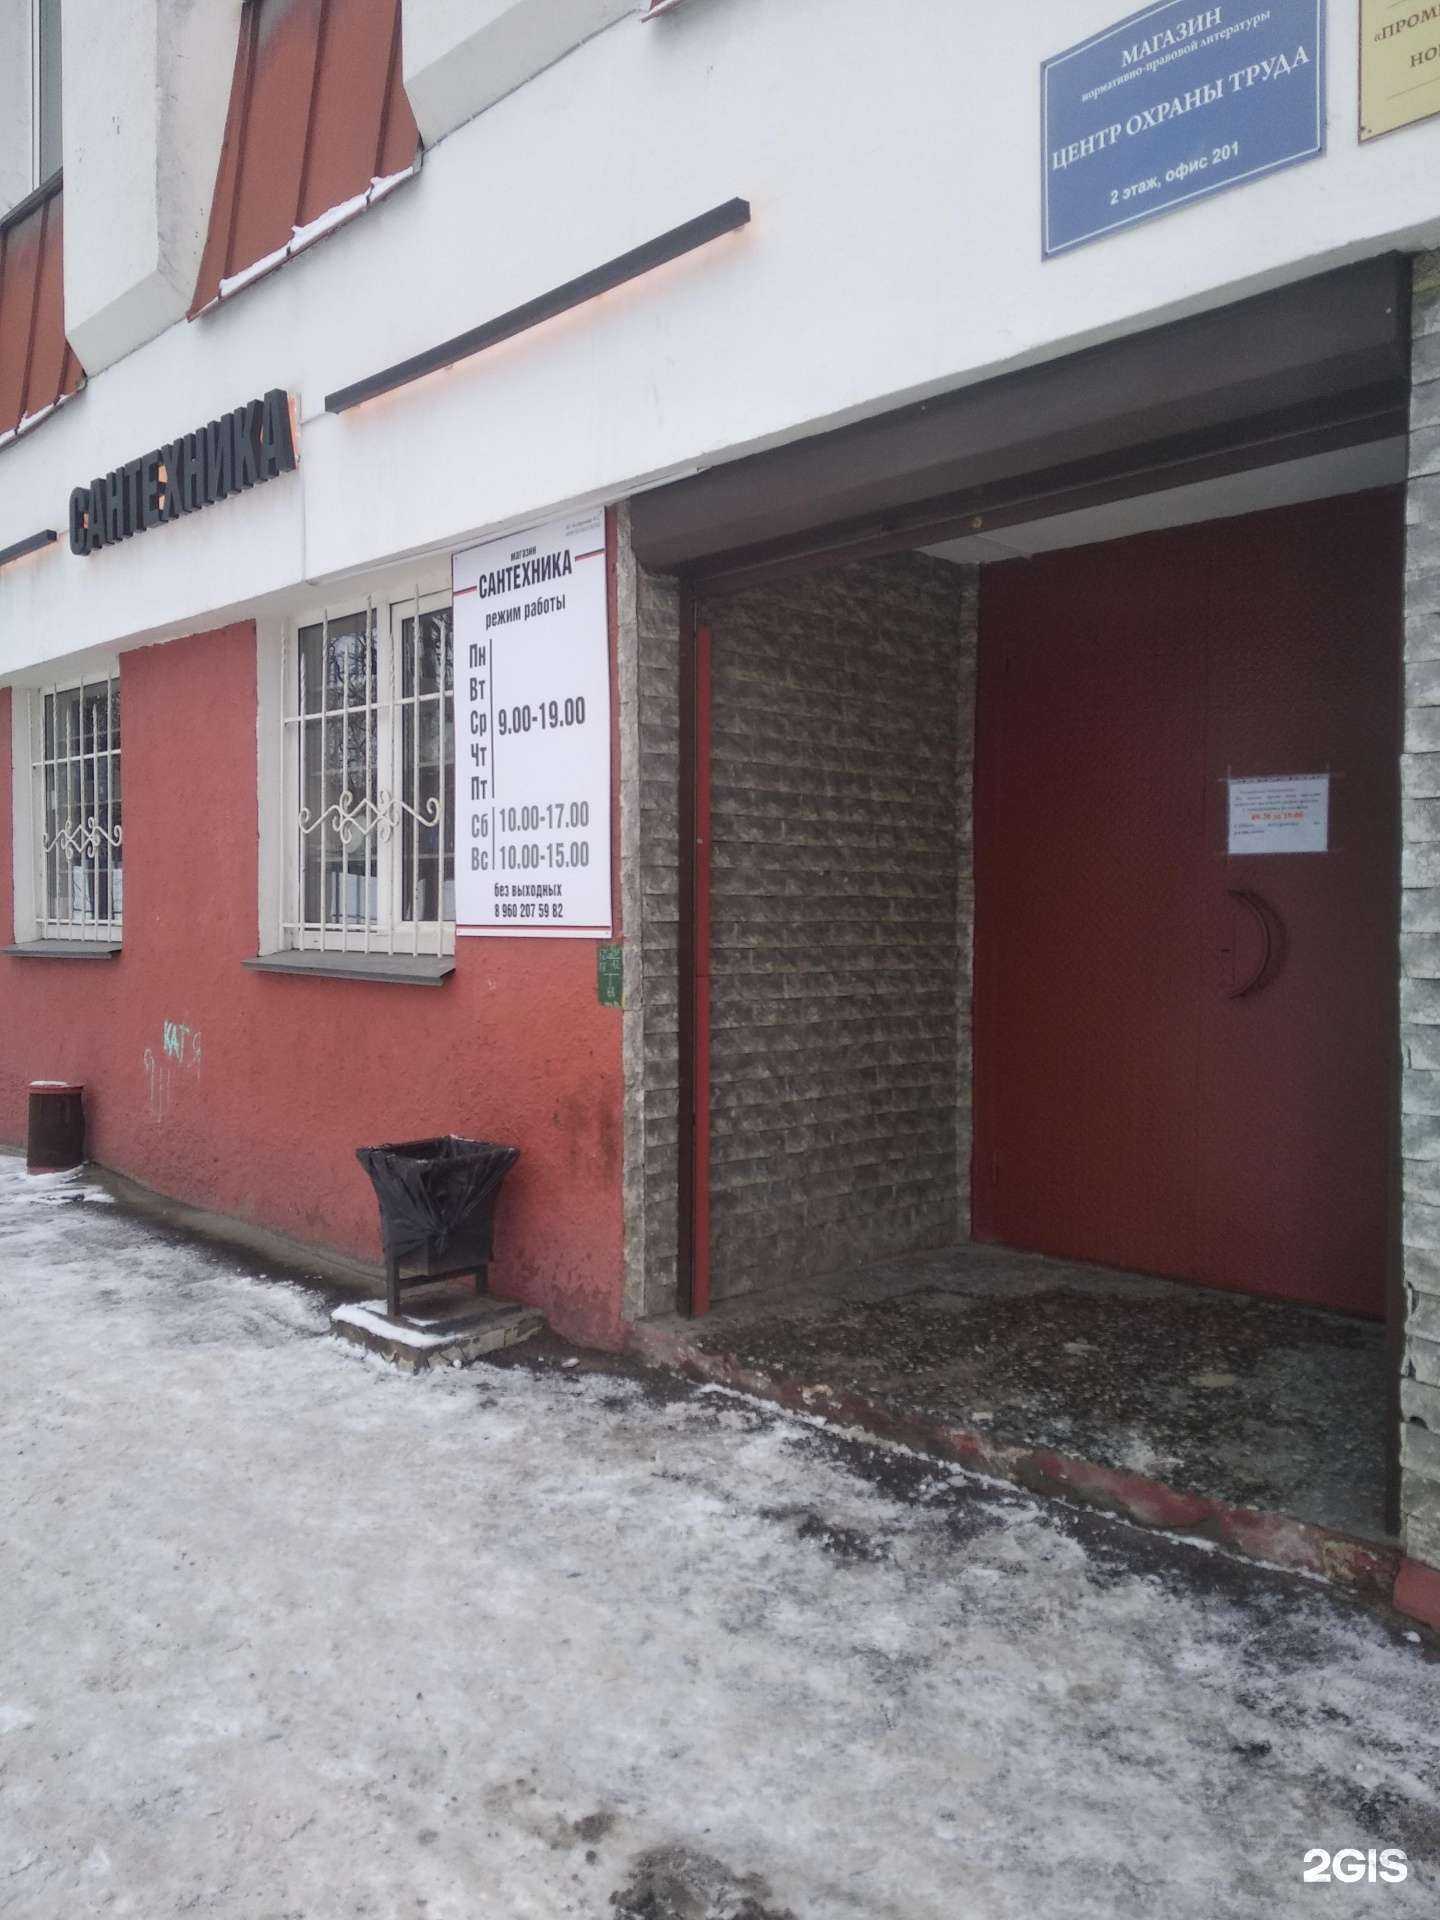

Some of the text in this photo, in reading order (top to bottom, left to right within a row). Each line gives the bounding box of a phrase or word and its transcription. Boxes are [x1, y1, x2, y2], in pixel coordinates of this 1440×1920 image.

[1120, 6, 1223, 67] МАГАЗИН
[1374, 4, 1440, 42] «ПРОМ
[1082, 10, 1271, 102] нормативно-правовой литературы
[1409, 44, 1440, 69] НО
[1052, 45, 1312, 171] ЦЕНТР ОХРАНЫ ТРУДА
[1109, 141, 1240, 205] 2 этаж, офис 201
[69, 388, 297, 556] САНТЕХНИКА
[510, 545, 537, 562] магазин
[479, 549, 573, 599] САНТЕХНИКА
[486, 594, 566, 630] режим работы
[469, 643, 486, 668] Пн
[469, 677, 486, 701] Вт
[470, 696, 586, 737] Ср 9.00-19.00
[471, 742, 487, 767] Чт
[471, 776, 487, 800] Пт
[471, 801, 590, 838] Сб 10.00-17.00
[471, 841, 590, 871] Вс 10.00-15.00
[494, 883, 562, 898] без выходных
[494, 903, 563, 918] 8 960 207 59 82
